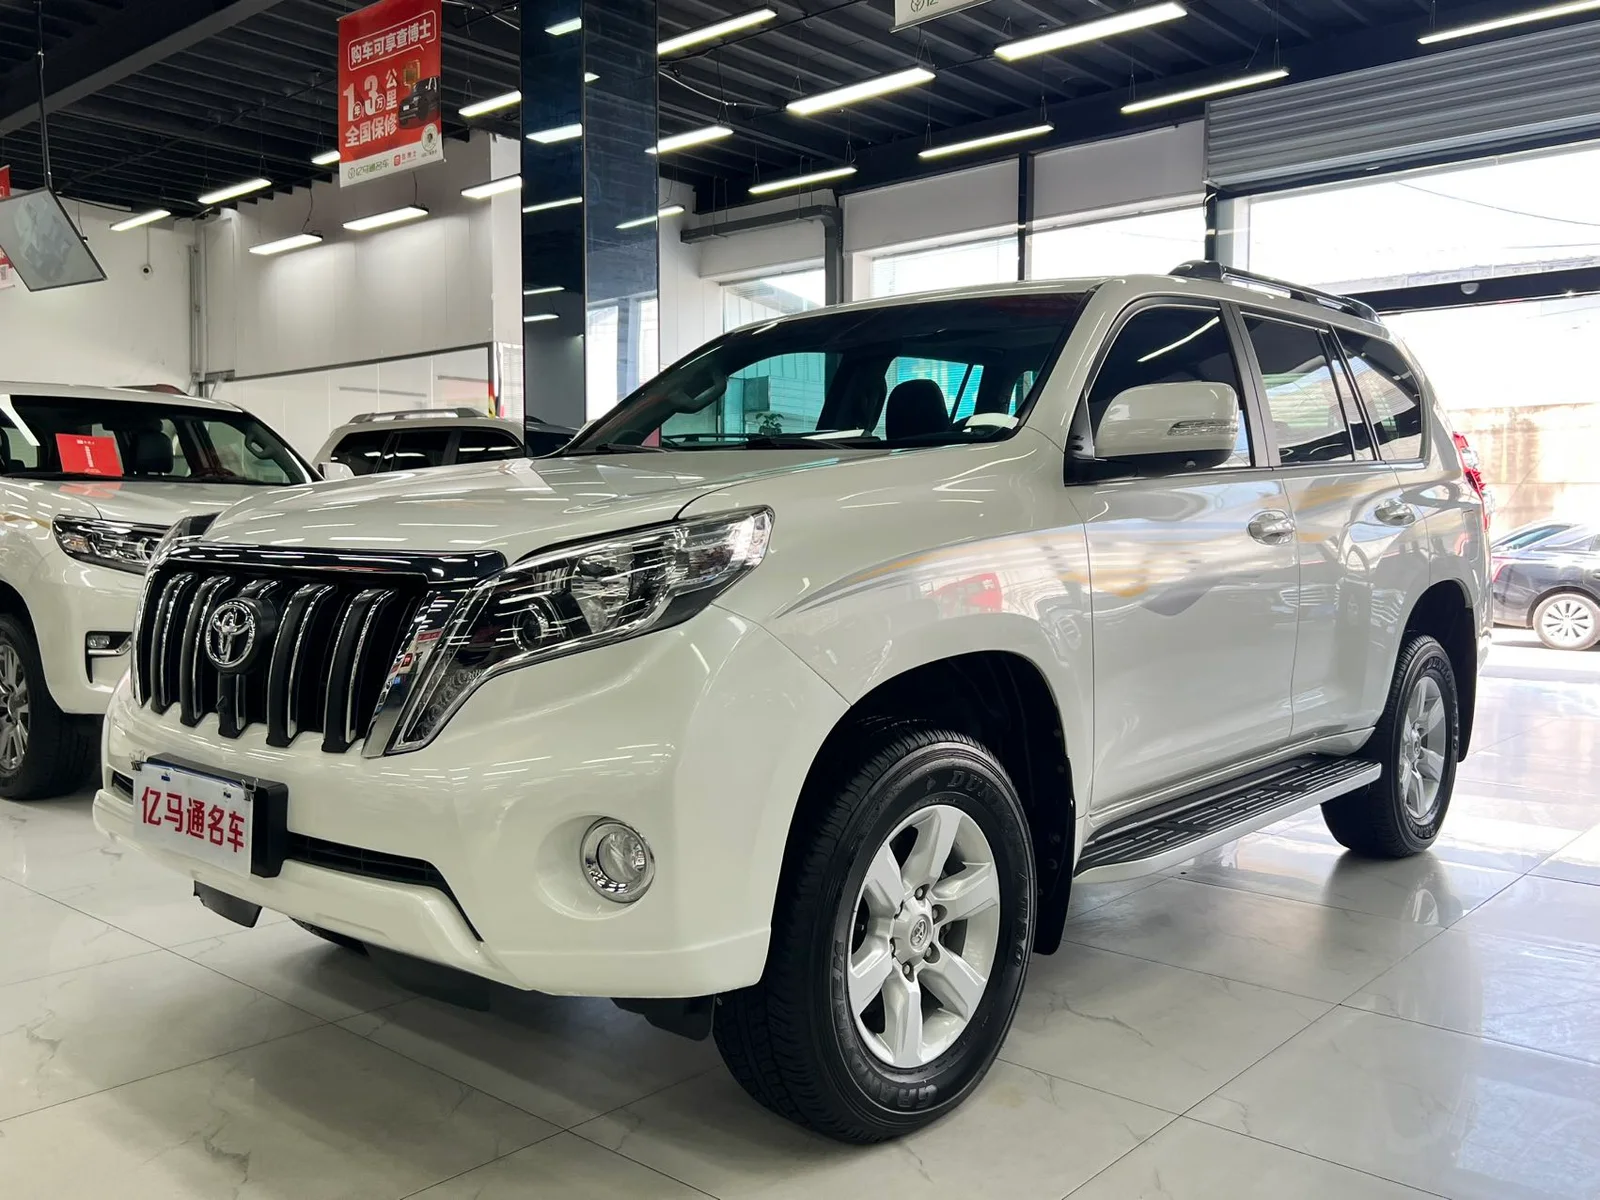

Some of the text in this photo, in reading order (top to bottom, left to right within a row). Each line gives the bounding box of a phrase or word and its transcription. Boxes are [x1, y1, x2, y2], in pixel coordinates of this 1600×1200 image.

[350, 19, 432, 65] 购车可享查博士
[345, 113, 398, 147] 全国保修
[141, 786, 245, 853] 亿马通名车
